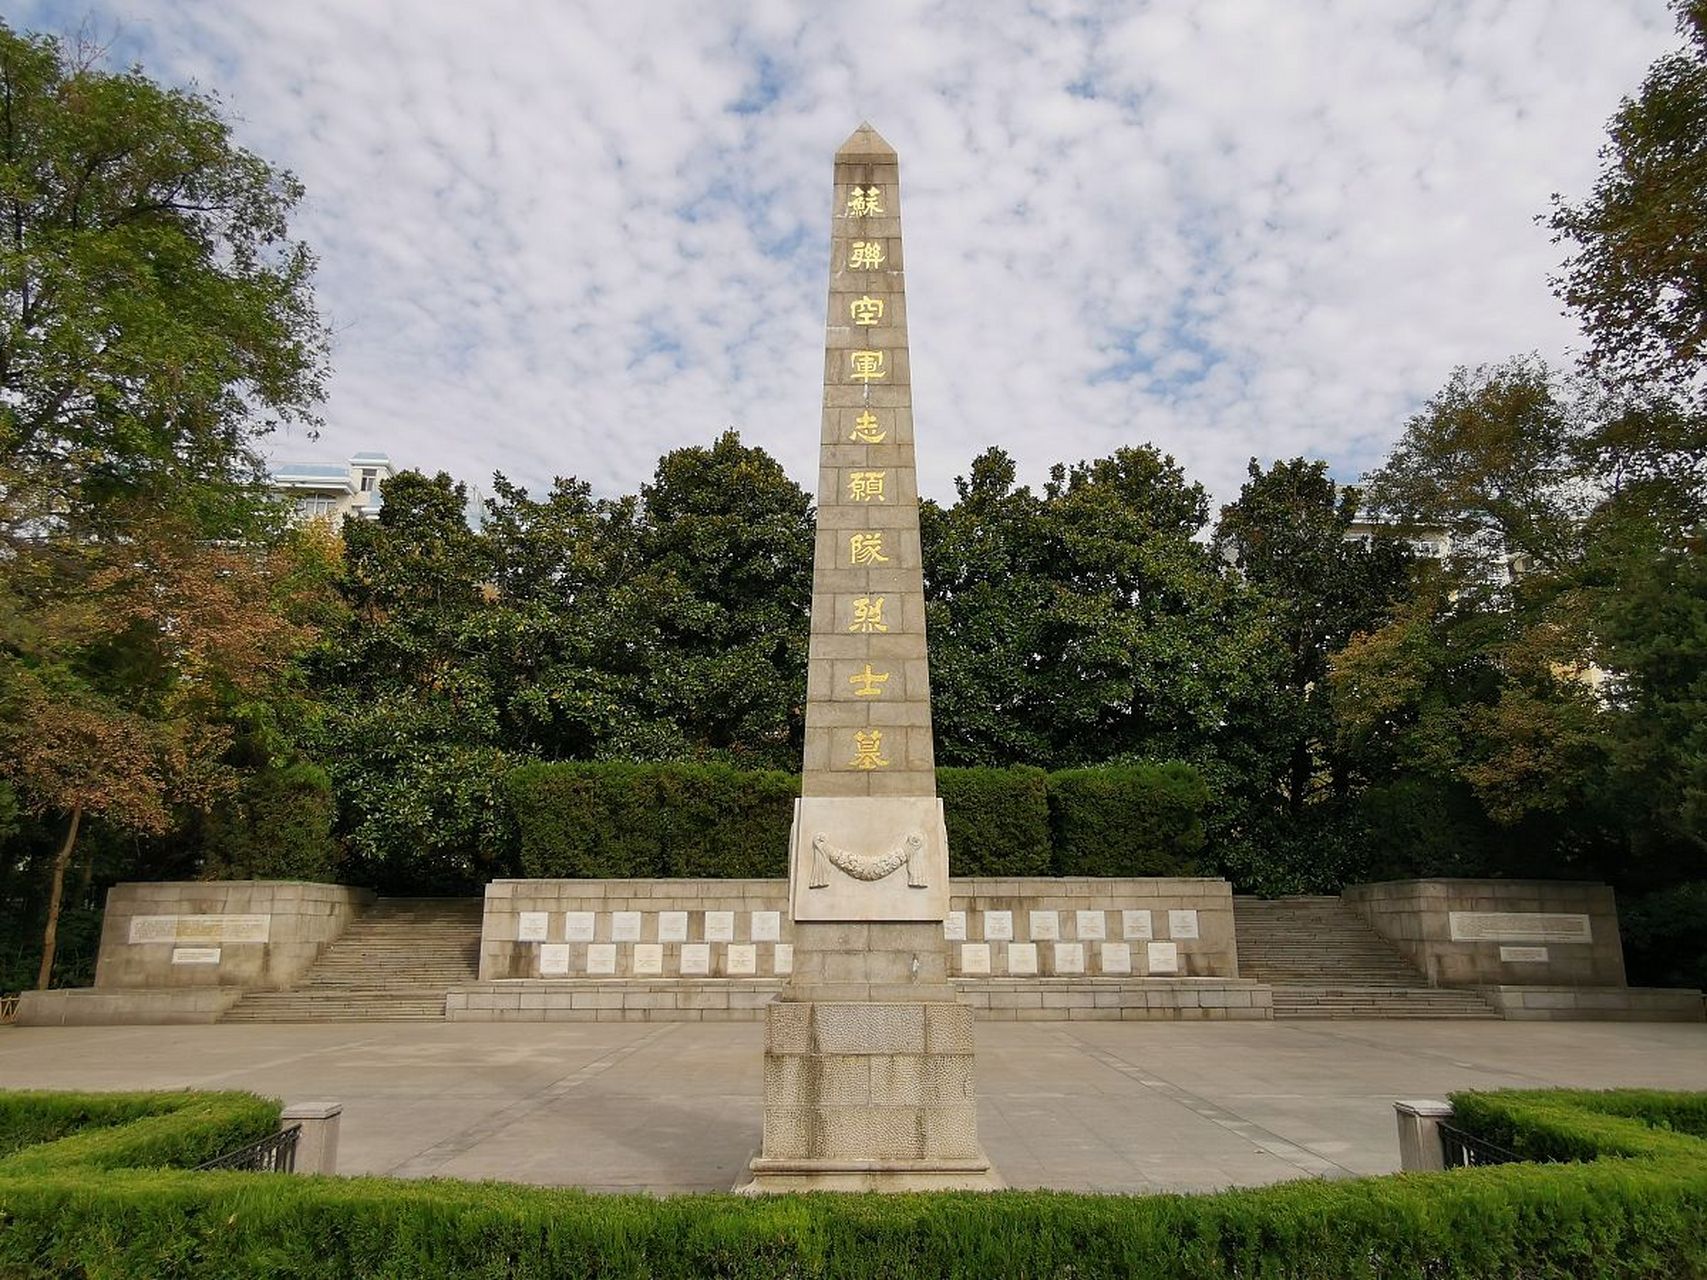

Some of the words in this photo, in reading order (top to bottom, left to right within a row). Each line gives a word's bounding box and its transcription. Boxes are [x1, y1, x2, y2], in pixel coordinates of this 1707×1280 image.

[847, 186, 890, 770] 蘇聯空軍志願隊烈士墓
